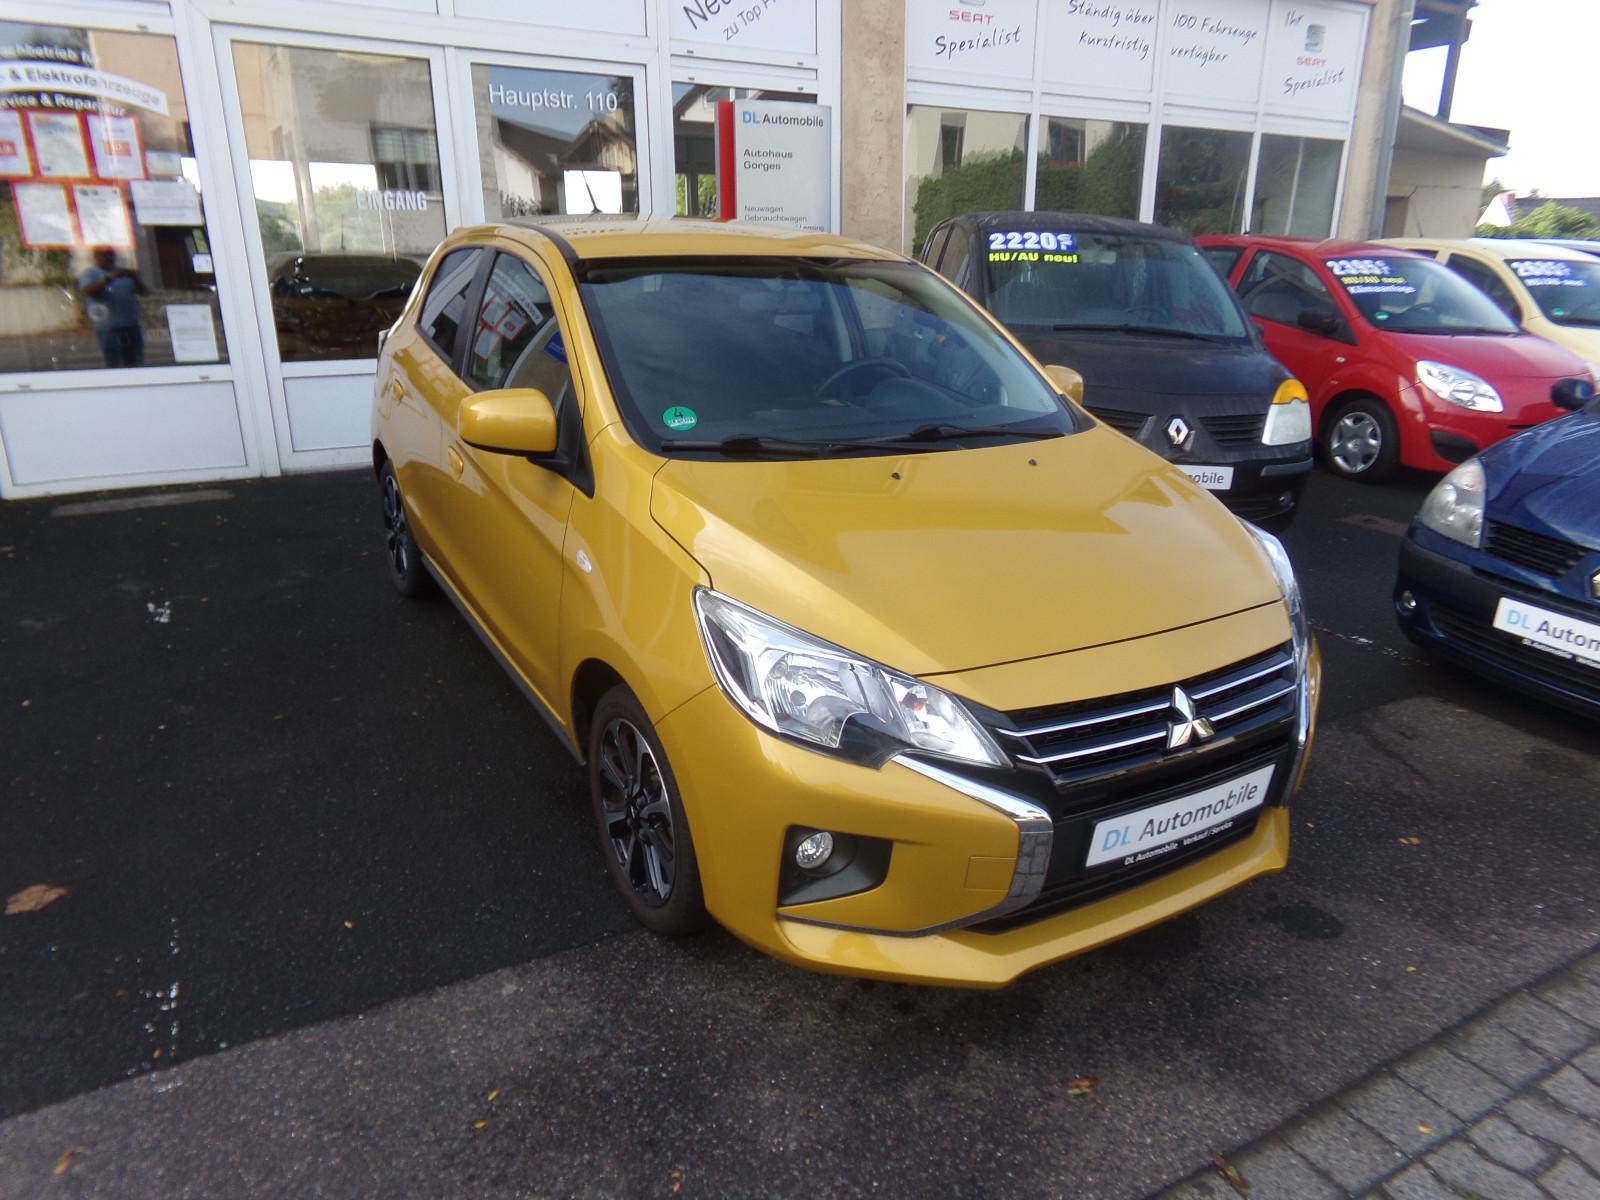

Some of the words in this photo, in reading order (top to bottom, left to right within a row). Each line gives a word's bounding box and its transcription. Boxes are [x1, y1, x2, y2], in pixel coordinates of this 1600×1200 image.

[723, 22, 740, 41] zu
[737, 4, 762, 26] Top
[948, 10, 994, 24] SEAT
[1067, 0, 1121, 28] Ständig
[1125, 8, 1155, 24] über
[1173, 13, 1198, 29] 100
[1201, 17, 1257, 46] Fahrzeuge
[1285, 10, 1305, 27] Ihr
[935, 24, 1021, 60] Spezialist
[1170, 45, 1229, 68] verfügbar
[1284, 67, 1345, 96] Spezialist
[488, 84, 577, 111] Hauptstr.
[585, 92, 618, 111] 110
[742, 111, 761, 124] DL
[762, 113, 824, 127] Automobile
[743, 148, 793, 159] Autohaus
[743, 161, 782, 172] Gorges
[355, 190, 427, 210] EINGANG
[988, 252, 1039, 262] HU/AU
[674, 407, 683, 418] 4
[1506, 609, 1530, 629] DL
[1102, 825, 1130, 852] DL
[1138, 782, 1258, 841] Automobile
